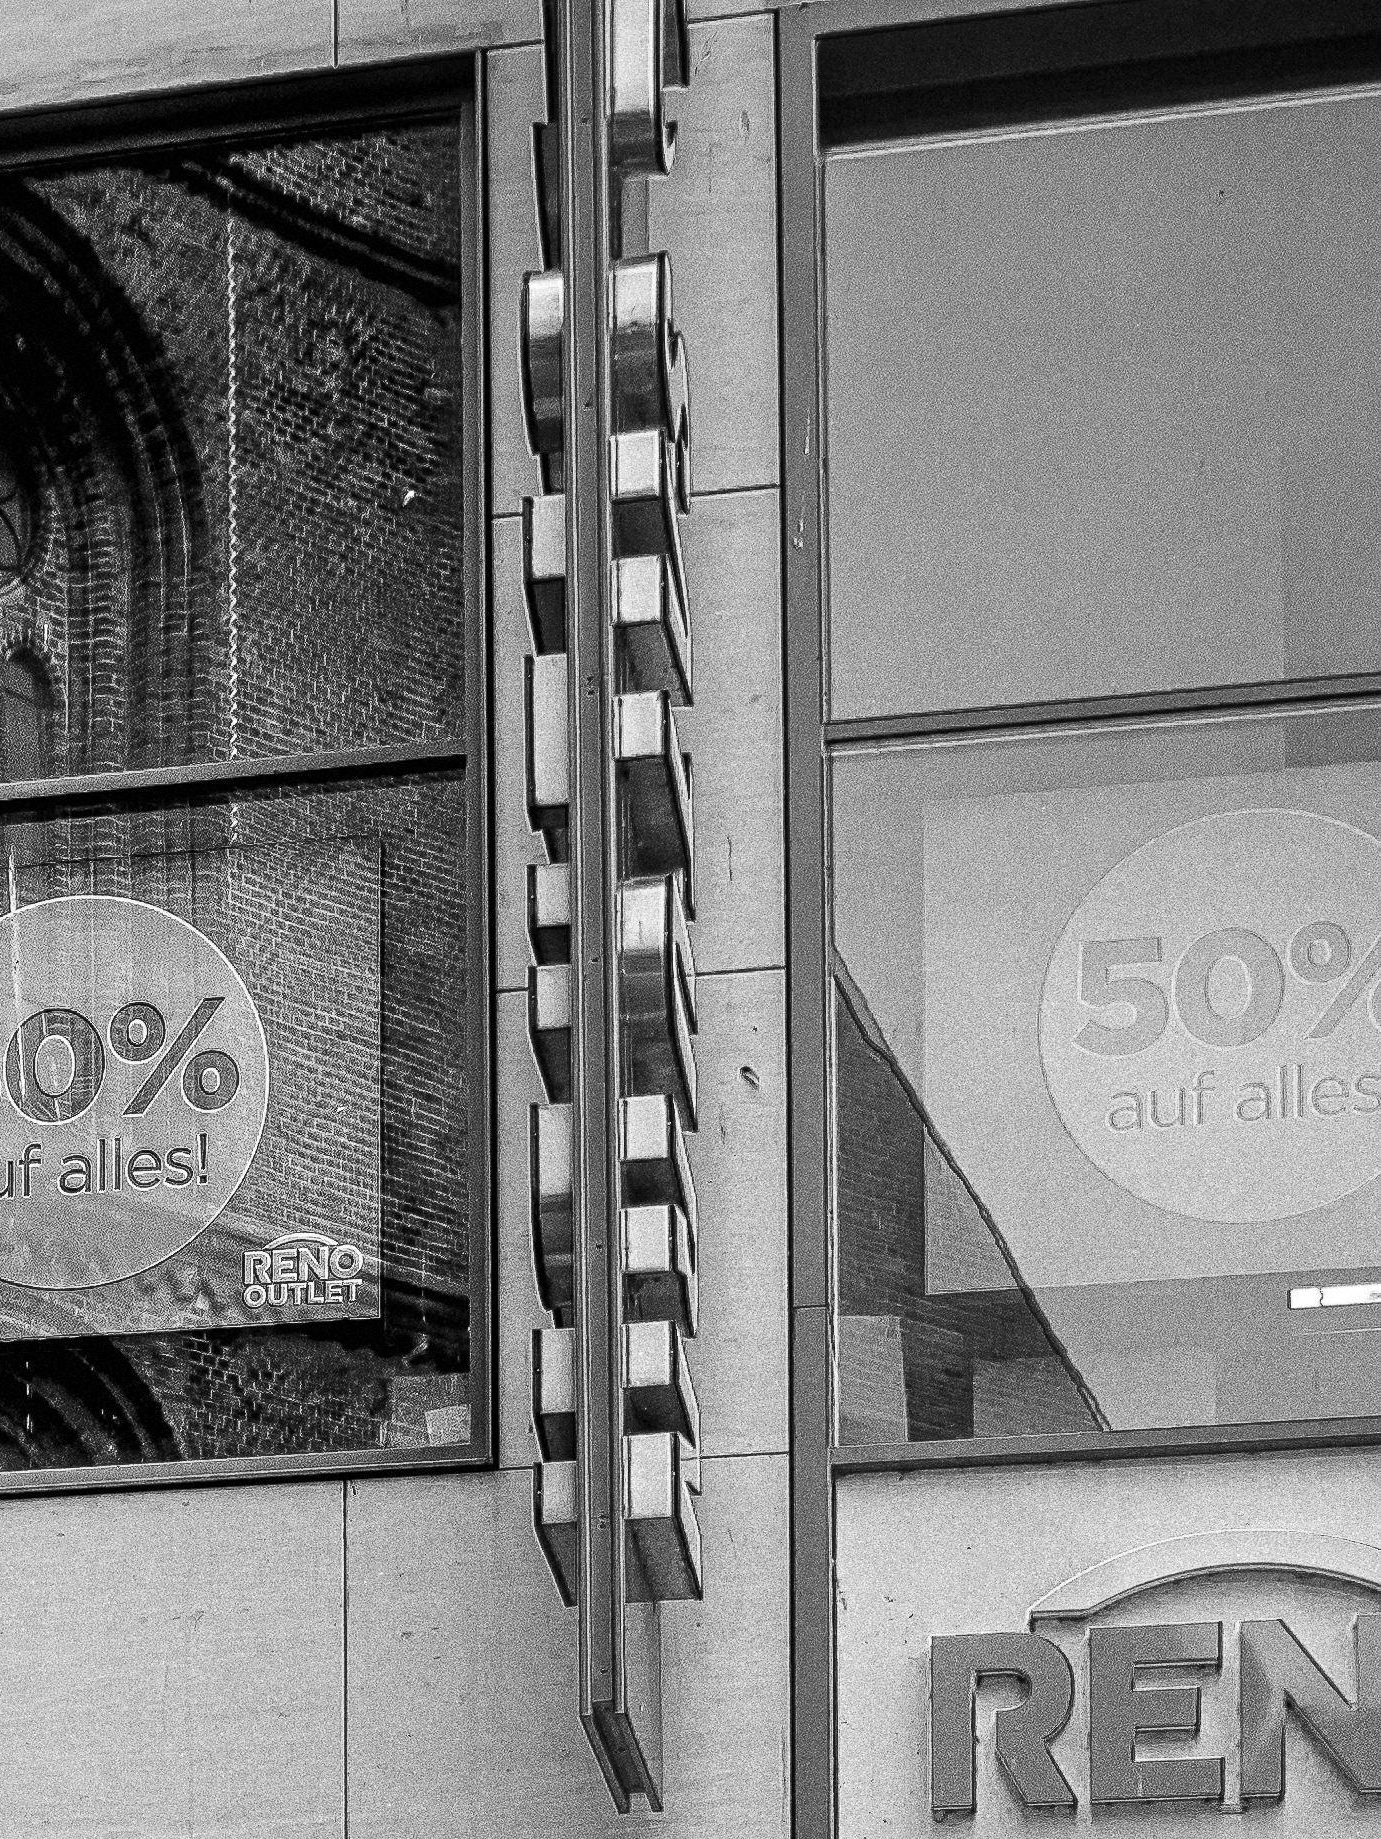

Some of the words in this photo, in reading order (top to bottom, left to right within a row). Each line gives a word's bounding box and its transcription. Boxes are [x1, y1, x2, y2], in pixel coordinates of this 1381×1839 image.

[1074, 921, 1381, 1056] 50%
[1107, 1070, 1215, 1132] auf
[59, 1134, 209, 1194] alles!
[243, 1243, 363, 1285] RENO
[243, 1280, 362, 1308] OUTLET
